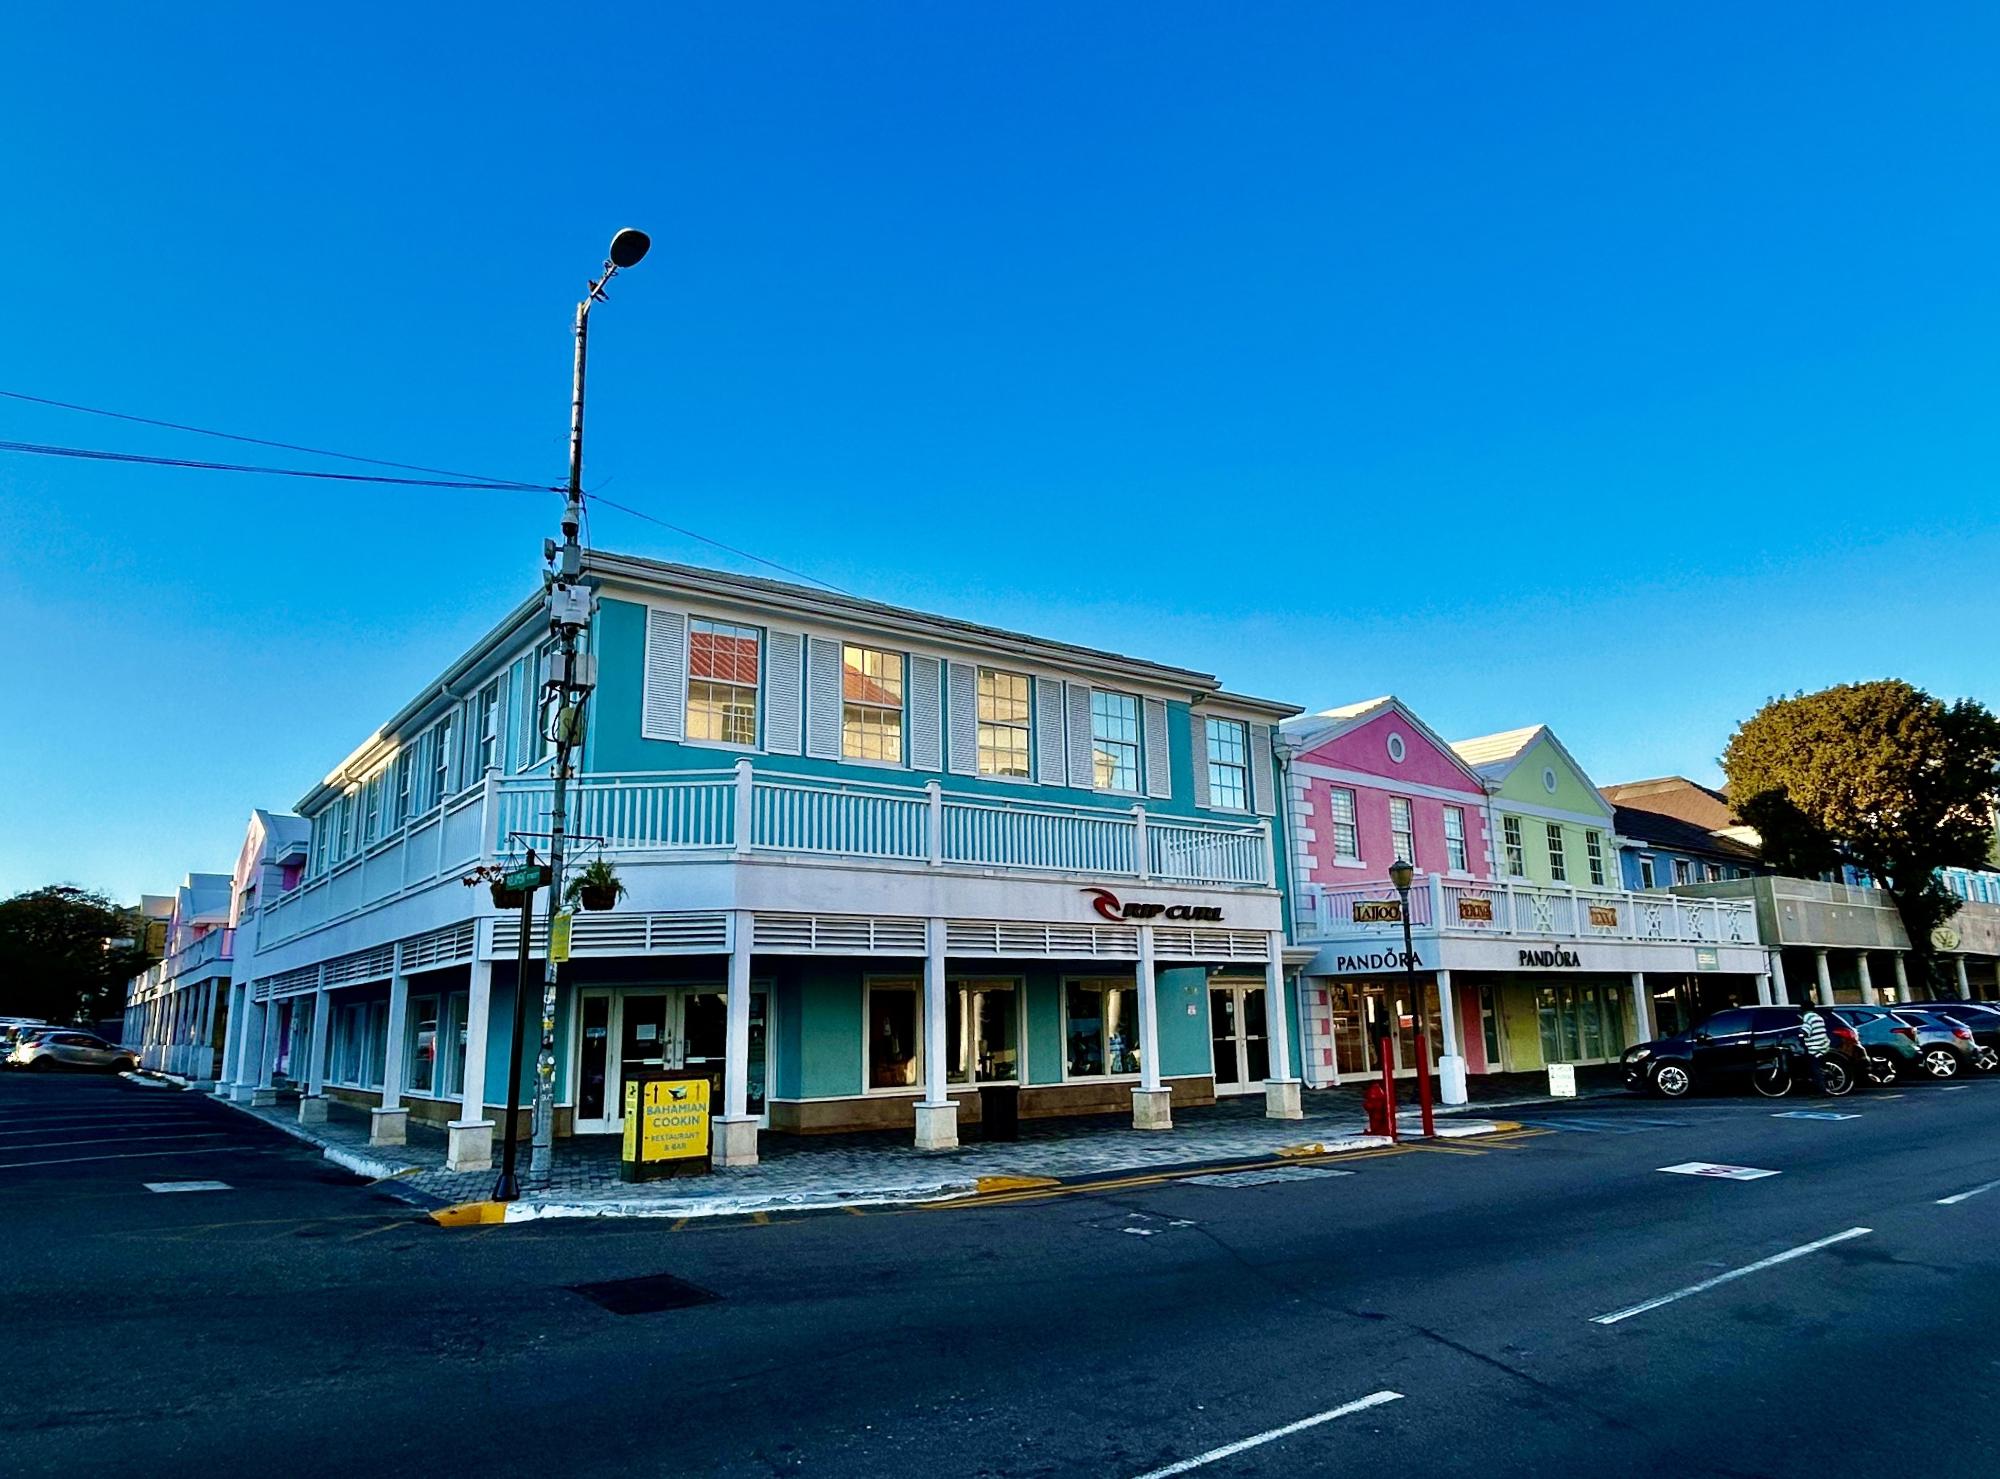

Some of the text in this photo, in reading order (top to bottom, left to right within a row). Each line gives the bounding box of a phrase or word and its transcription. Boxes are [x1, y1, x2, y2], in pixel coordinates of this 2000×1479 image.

[1122, 902, 1224, 921] RIP CURL
[1519, 948, 1581, 967] PANDORA
[646, 1103, 706, 1115] BAHAMIAN
[653, 1116, 700, 1127] COOKIN
[651, 1132, 700, 1142] RESTAURANT
